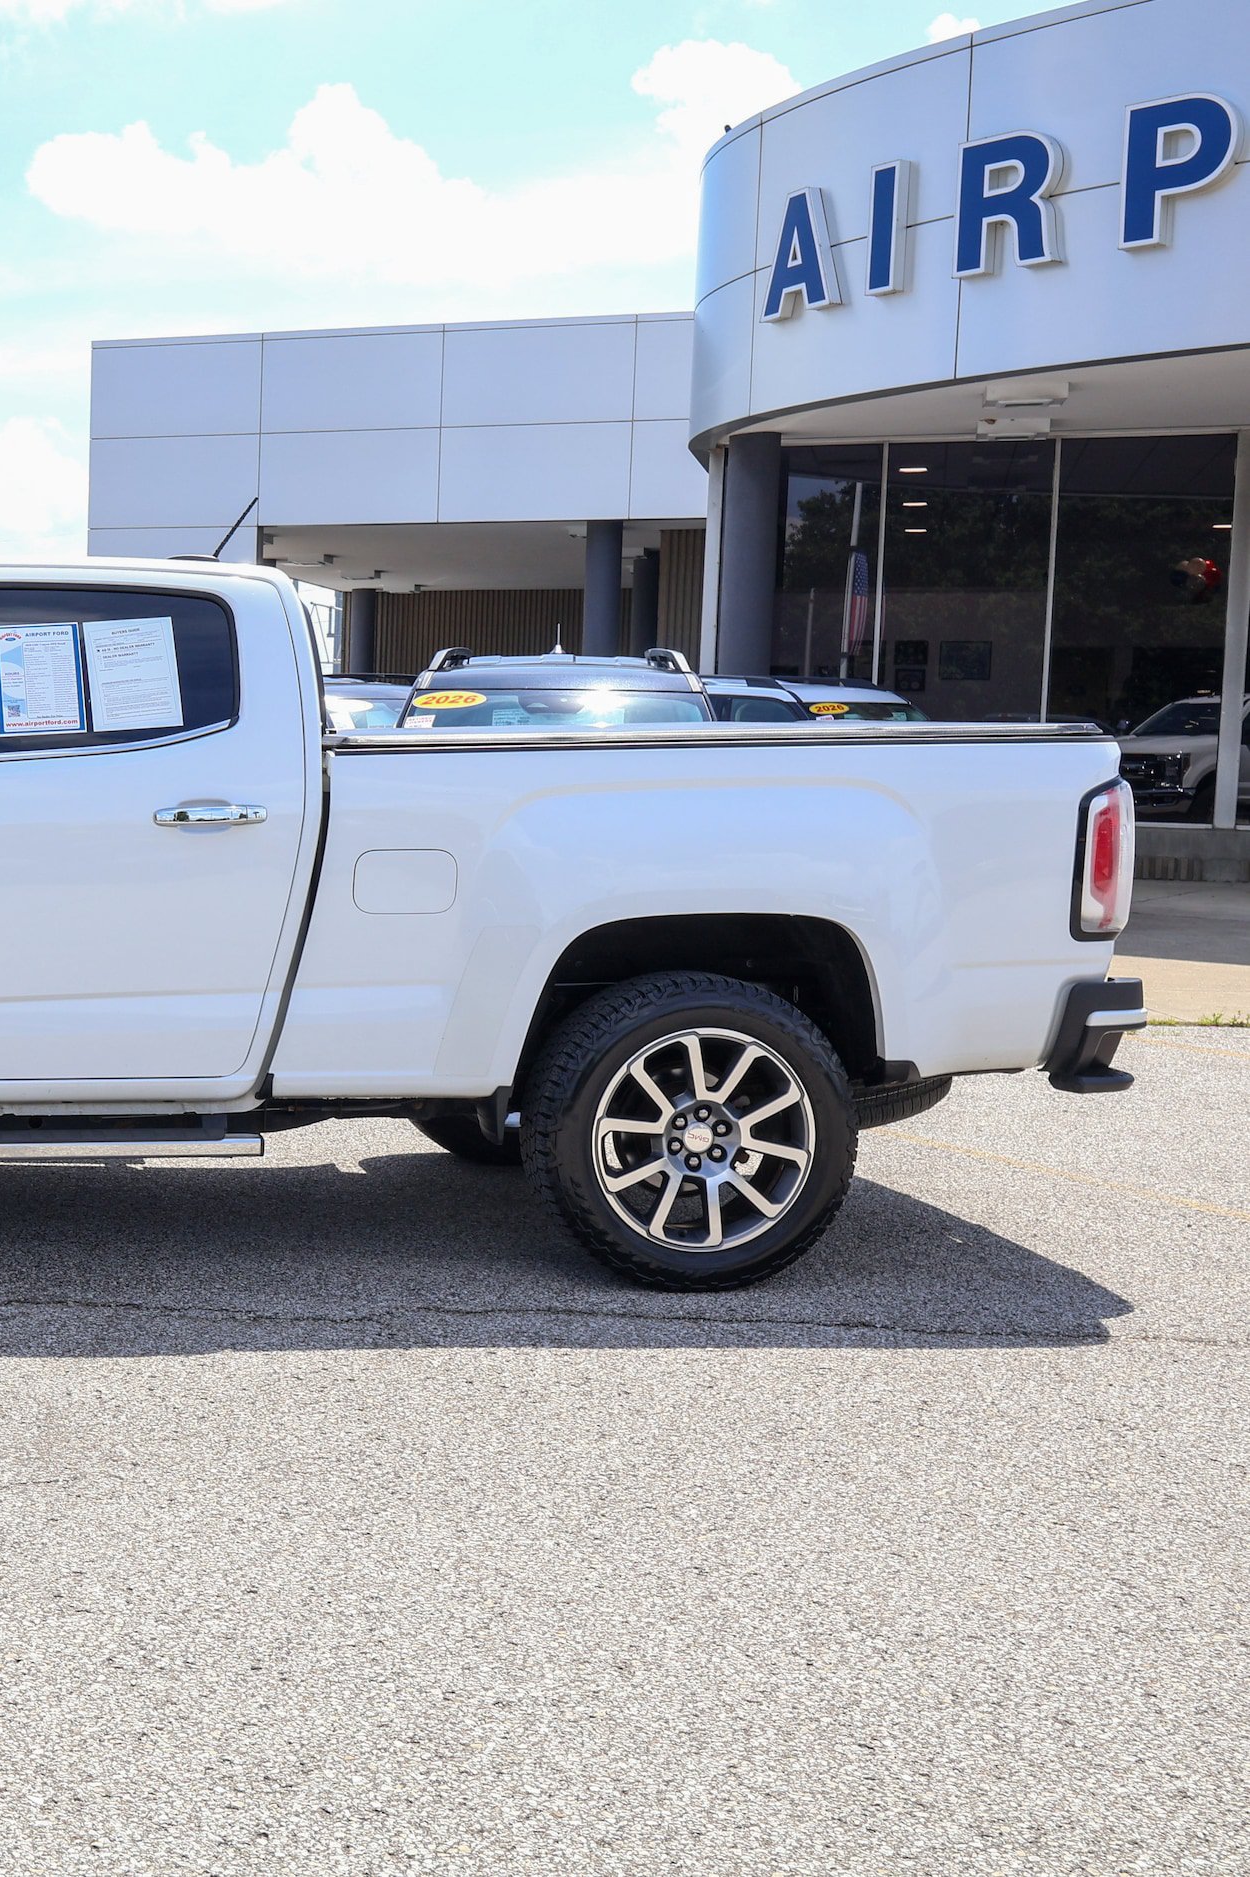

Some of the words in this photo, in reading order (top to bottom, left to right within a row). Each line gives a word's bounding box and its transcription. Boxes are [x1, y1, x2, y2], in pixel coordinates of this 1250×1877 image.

[759, 91, 1245, 324] AIRP
[421, 695, 478, 706] 2026
[814, 702, 845, 713] 2026
[5, 719, 78, 728] www.airportford.com
[687, 1131, 710, 1143] GMC
